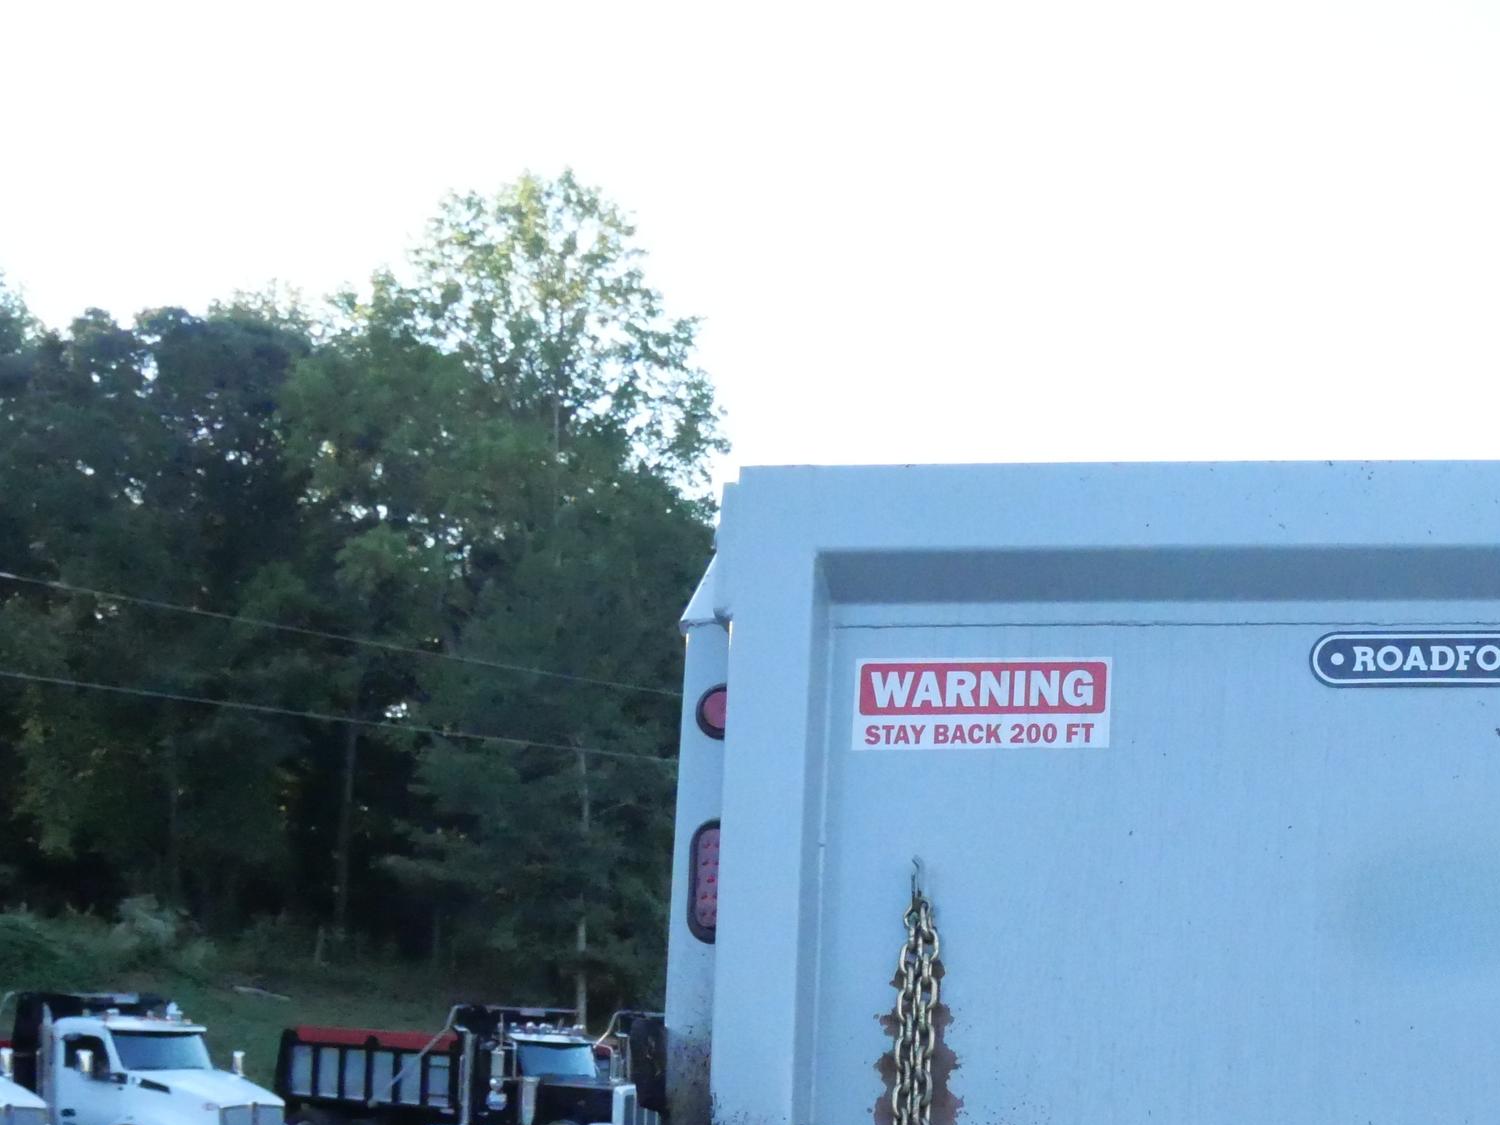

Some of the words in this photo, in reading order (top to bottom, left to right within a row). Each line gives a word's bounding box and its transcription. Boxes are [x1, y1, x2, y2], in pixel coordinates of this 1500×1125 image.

[871, 669, 1094, 708] WARNING
[865, 724, 926, 745] STAY
[933, 723, 1002, 745] BACK
[1010, 723, 1057, 744] 200
[1066, 722, 1094, 743] FT
